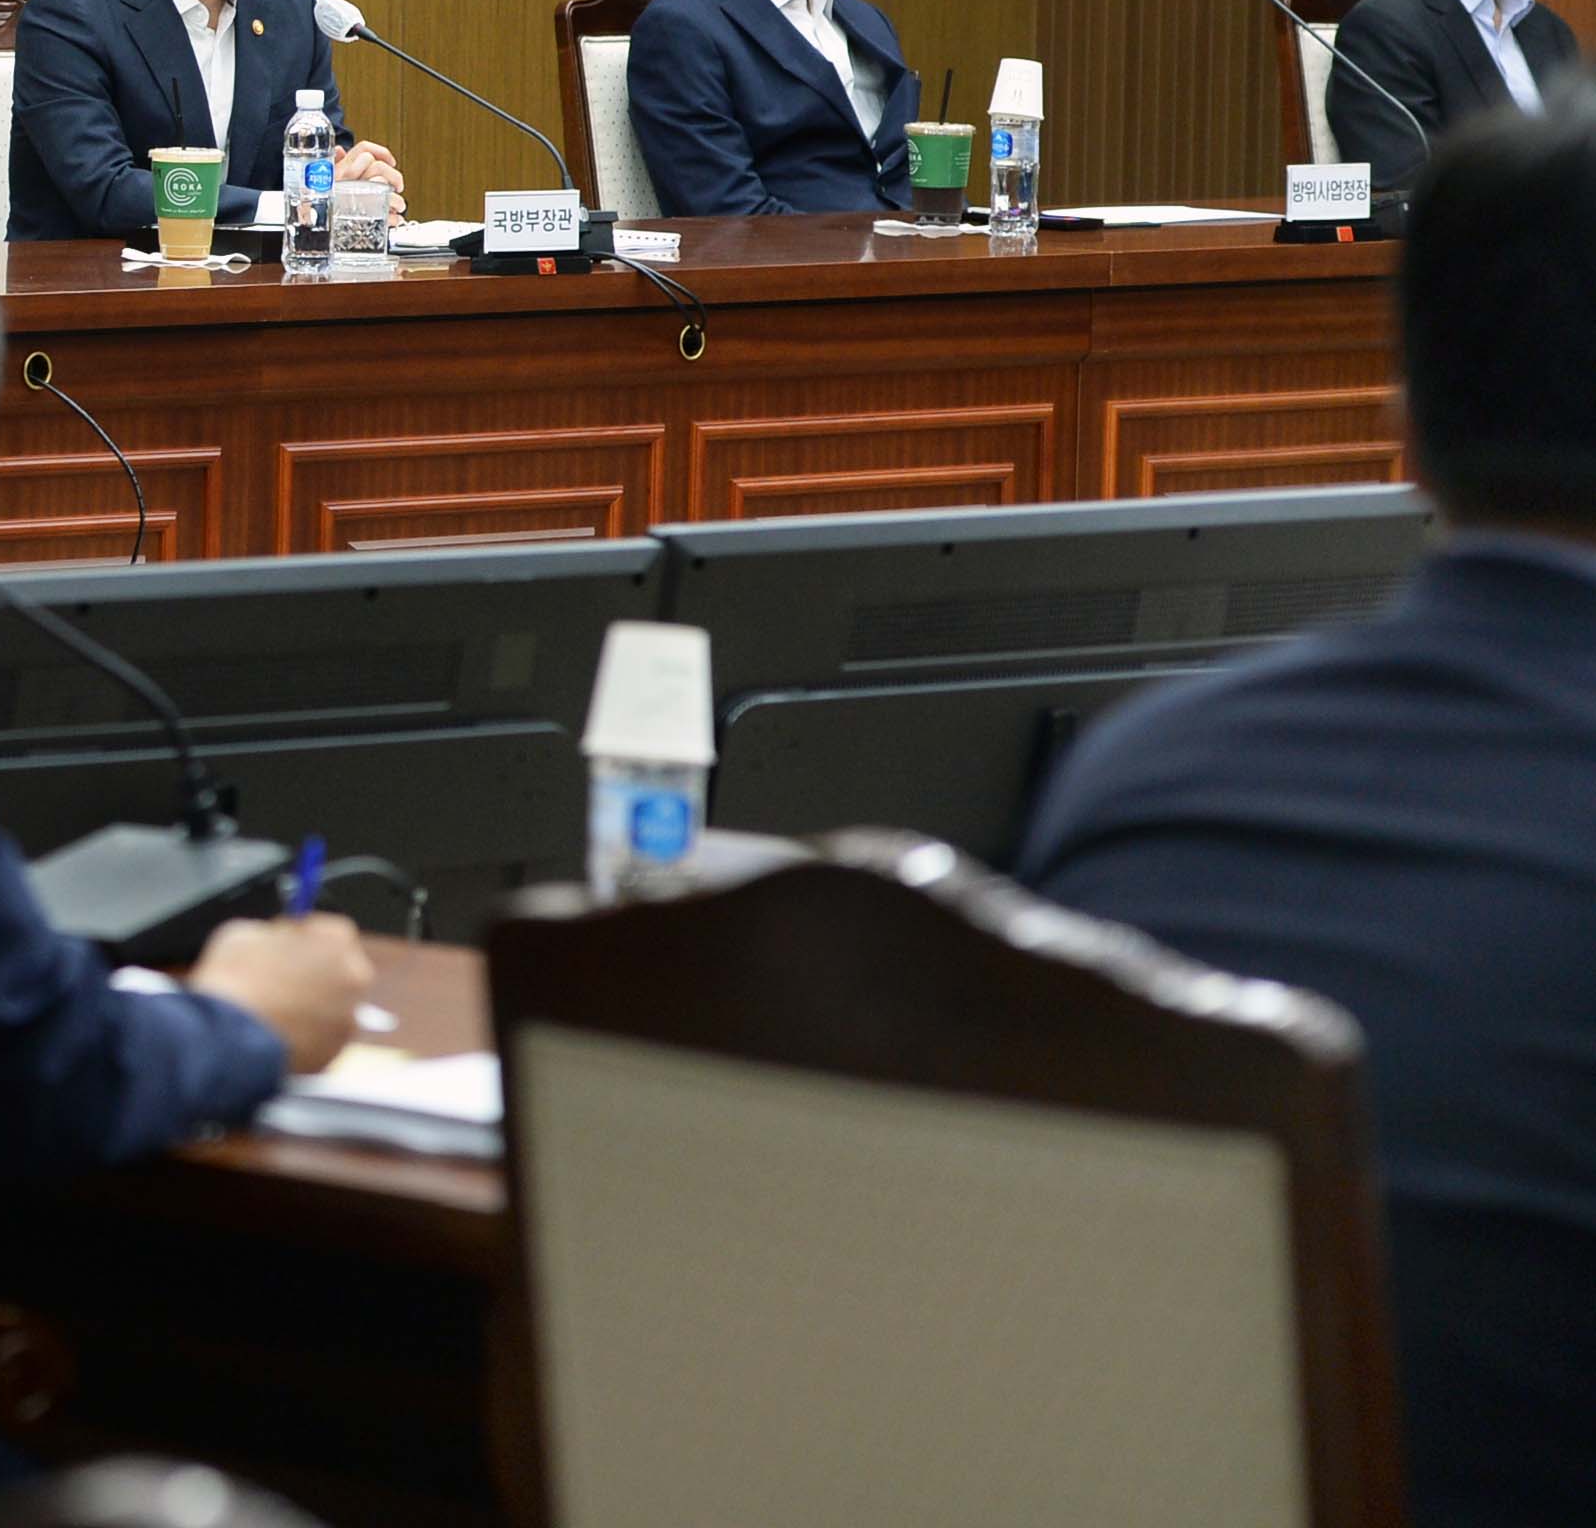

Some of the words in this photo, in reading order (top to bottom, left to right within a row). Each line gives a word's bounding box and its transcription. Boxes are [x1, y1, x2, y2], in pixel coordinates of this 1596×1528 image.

[172, 183, 203, 192] ROKA
[1292, 179, 1369, 203] 방위사업청장
[493, 207, 573, 233] 국방부장관
